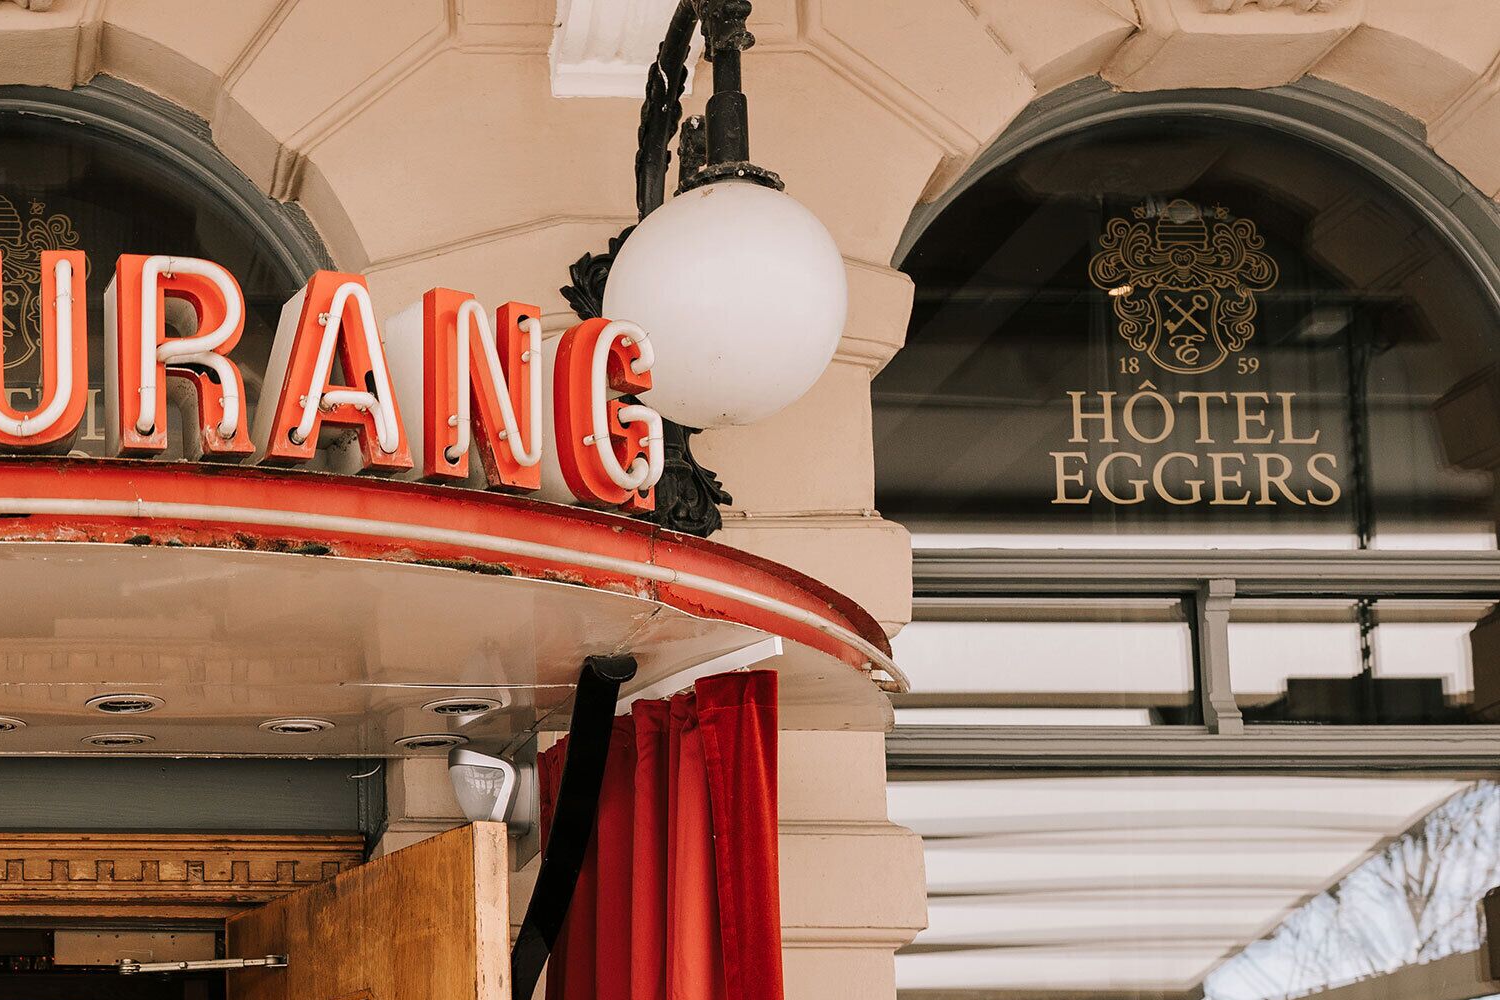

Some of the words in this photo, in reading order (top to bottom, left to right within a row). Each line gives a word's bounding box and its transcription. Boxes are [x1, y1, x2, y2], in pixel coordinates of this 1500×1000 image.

[1119, 356, 1140, 374] 18
[1237, 357, 1260, 375] 59
[1065, 379, 1320, 445] HÔTEL
[1049, 451, 1342, 506] EGGERS
